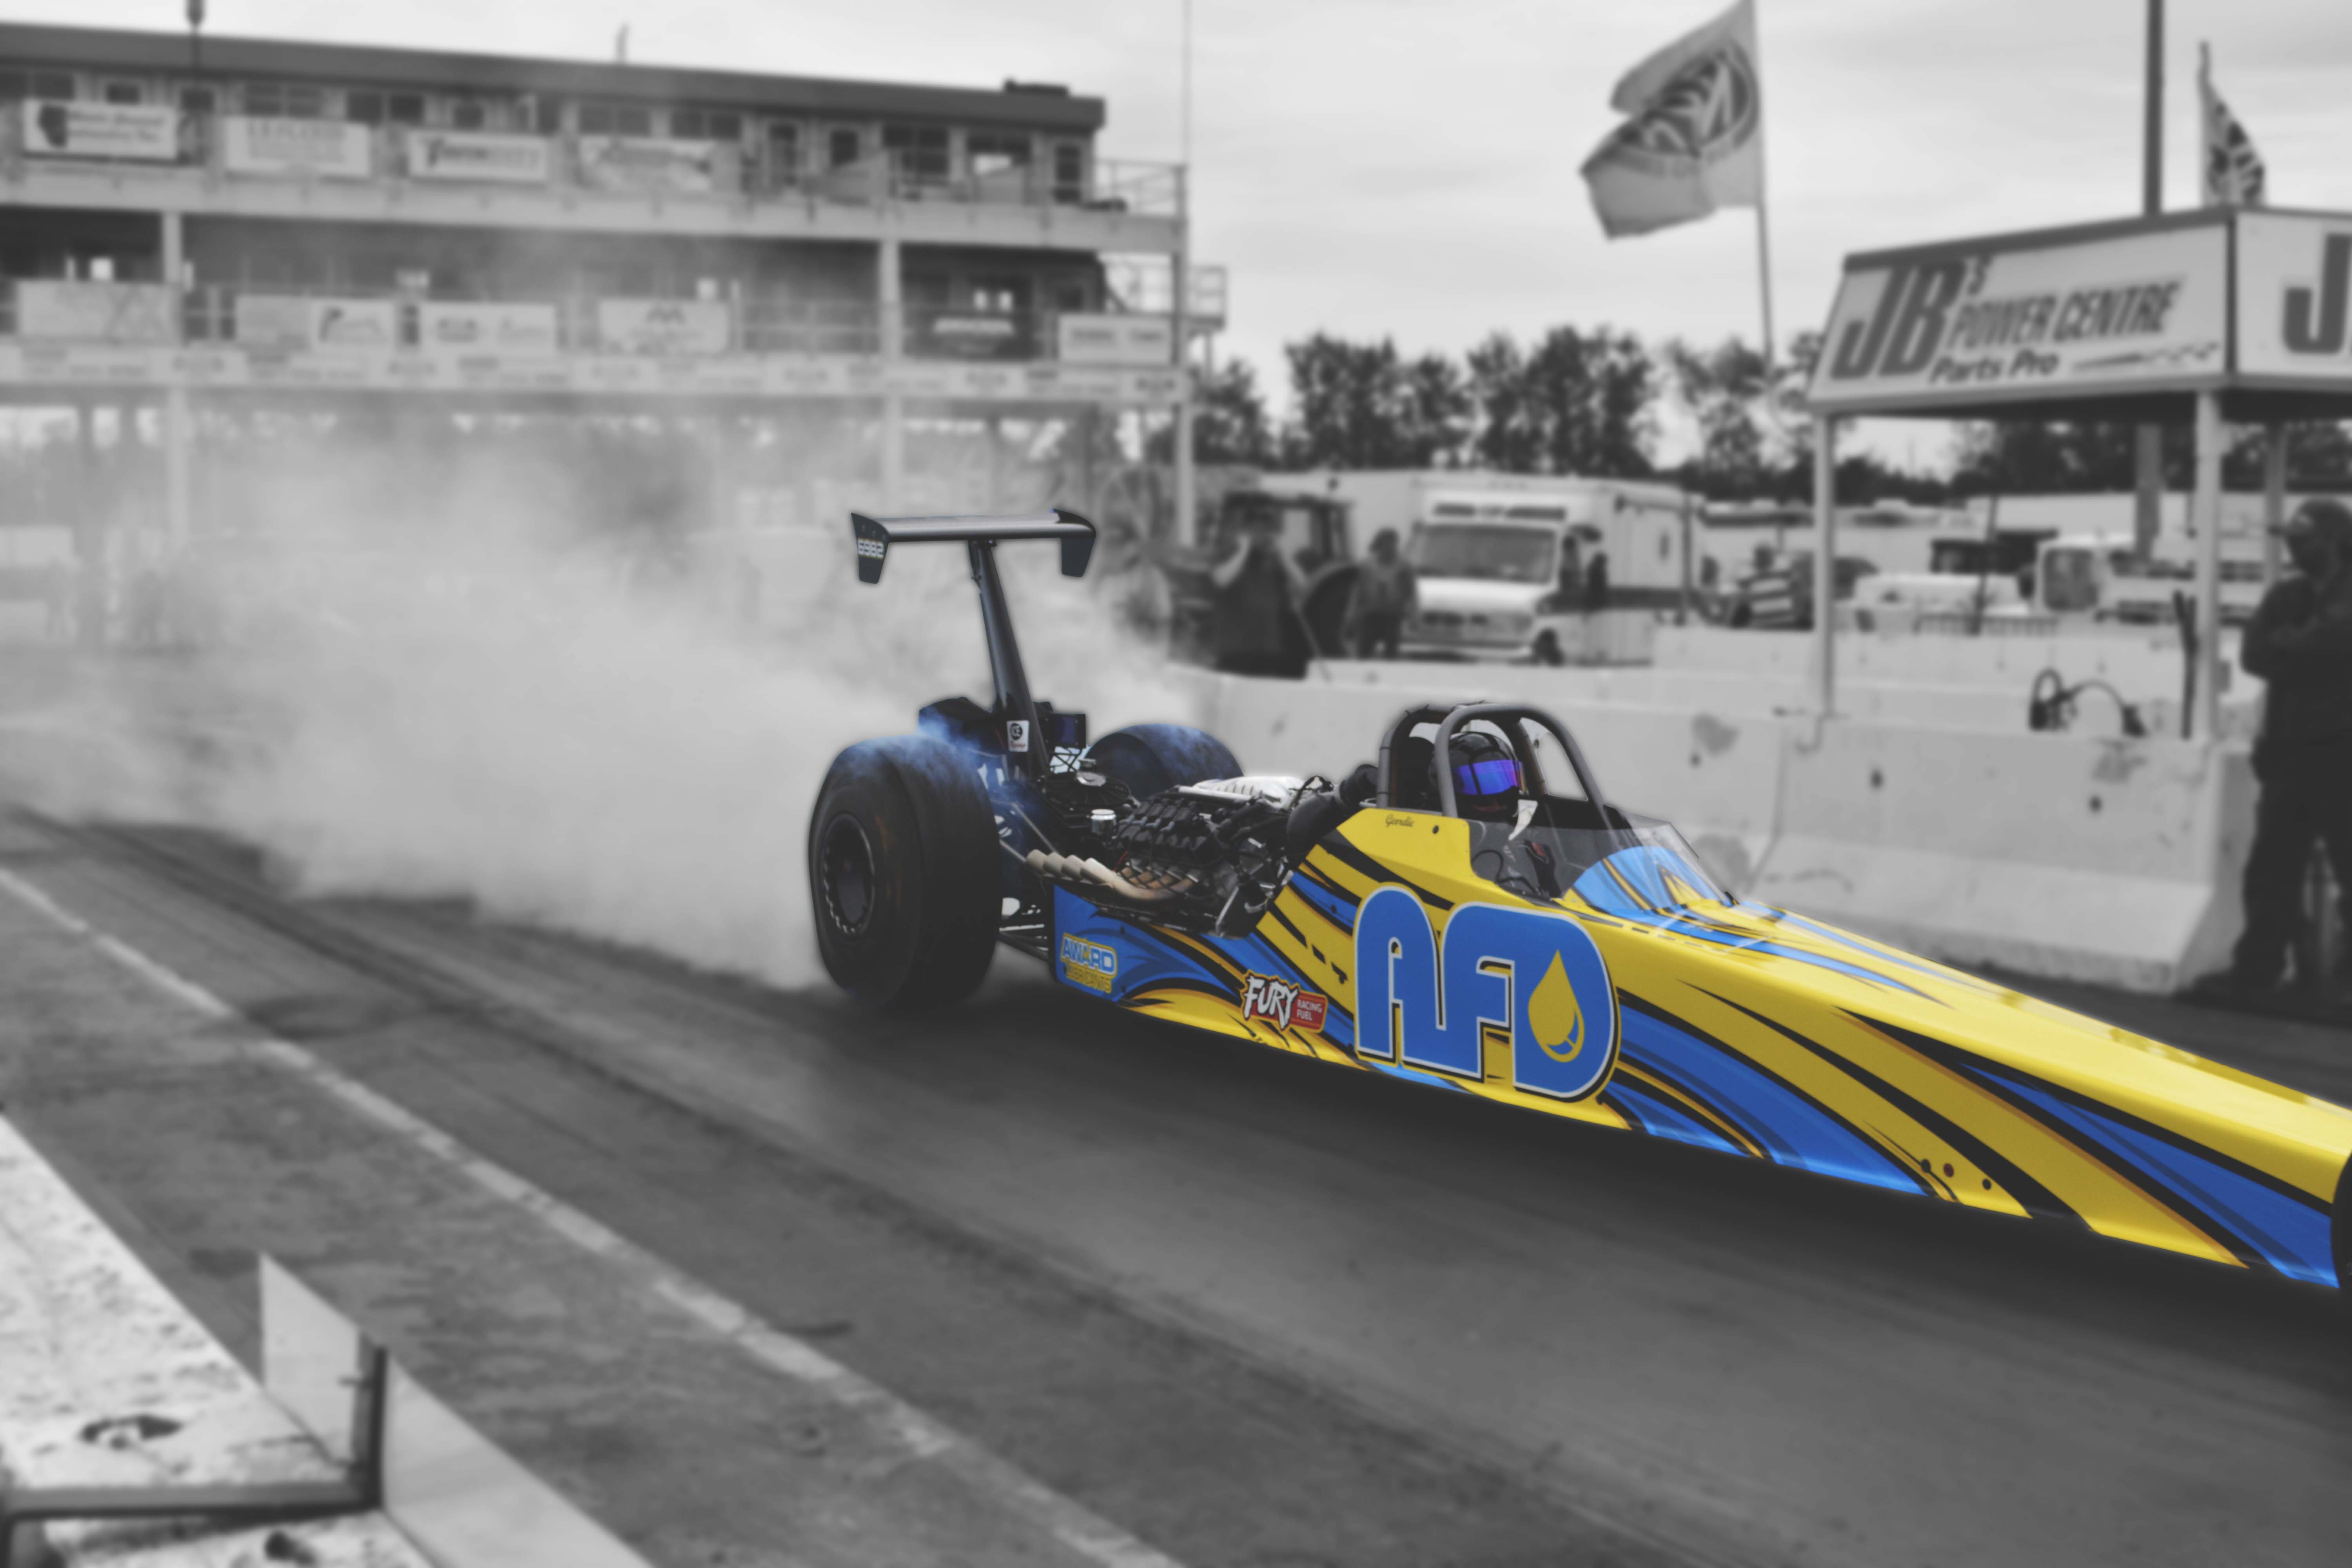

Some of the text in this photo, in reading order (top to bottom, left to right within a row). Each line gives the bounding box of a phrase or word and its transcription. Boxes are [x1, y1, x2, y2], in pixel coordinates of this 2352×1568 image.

[1946, 281, 2182, 350] POWER CENTRE
[1929, 348, 2060, 385] Parts Pro
[1061, 936, 1116, 976] AWARD
[1065, 964, 1112, 994] LUBRICANTS
[1355, 885, 1615, 1098] AFD
[1243, 975, 1299, 1029] FURY
[1296, 999, 1323, 1014] RACING
[1296, 1009, 1313, 1021] FUEL
